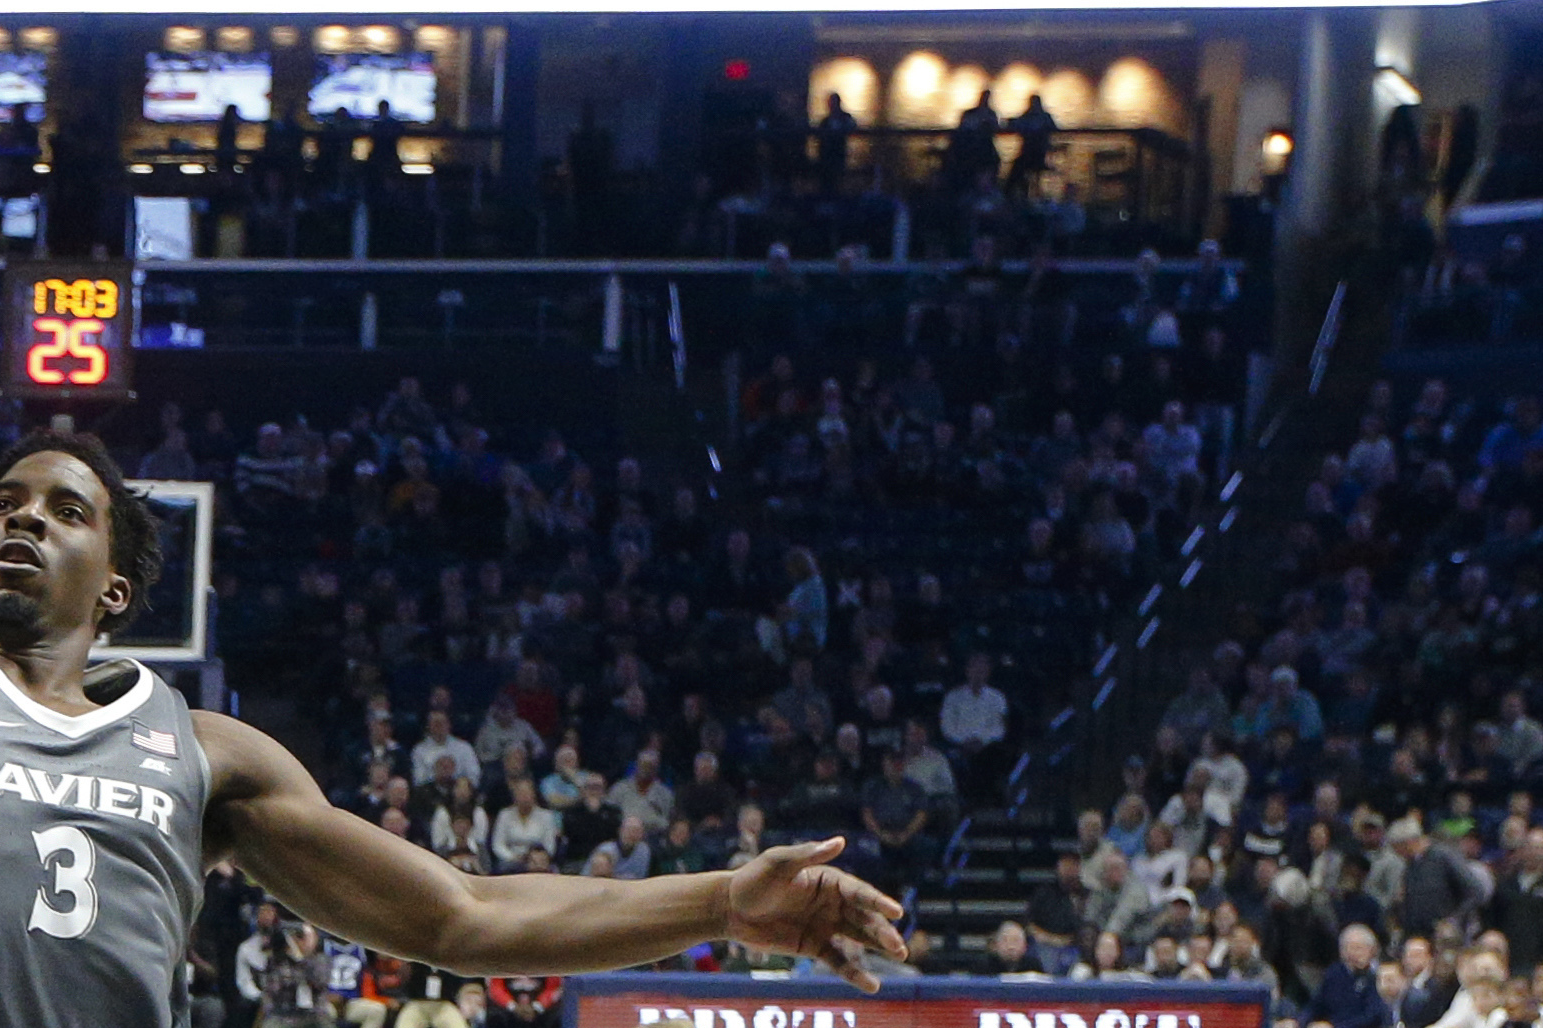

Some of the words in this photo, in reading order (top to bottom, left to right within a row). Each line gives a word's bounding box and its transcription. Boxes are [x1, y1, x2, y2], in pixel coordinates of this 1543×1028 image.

[34, 278, 119, 318] 17:03
[27, 318, 109, 385] 25
[27, 825, 100, 939] 3
